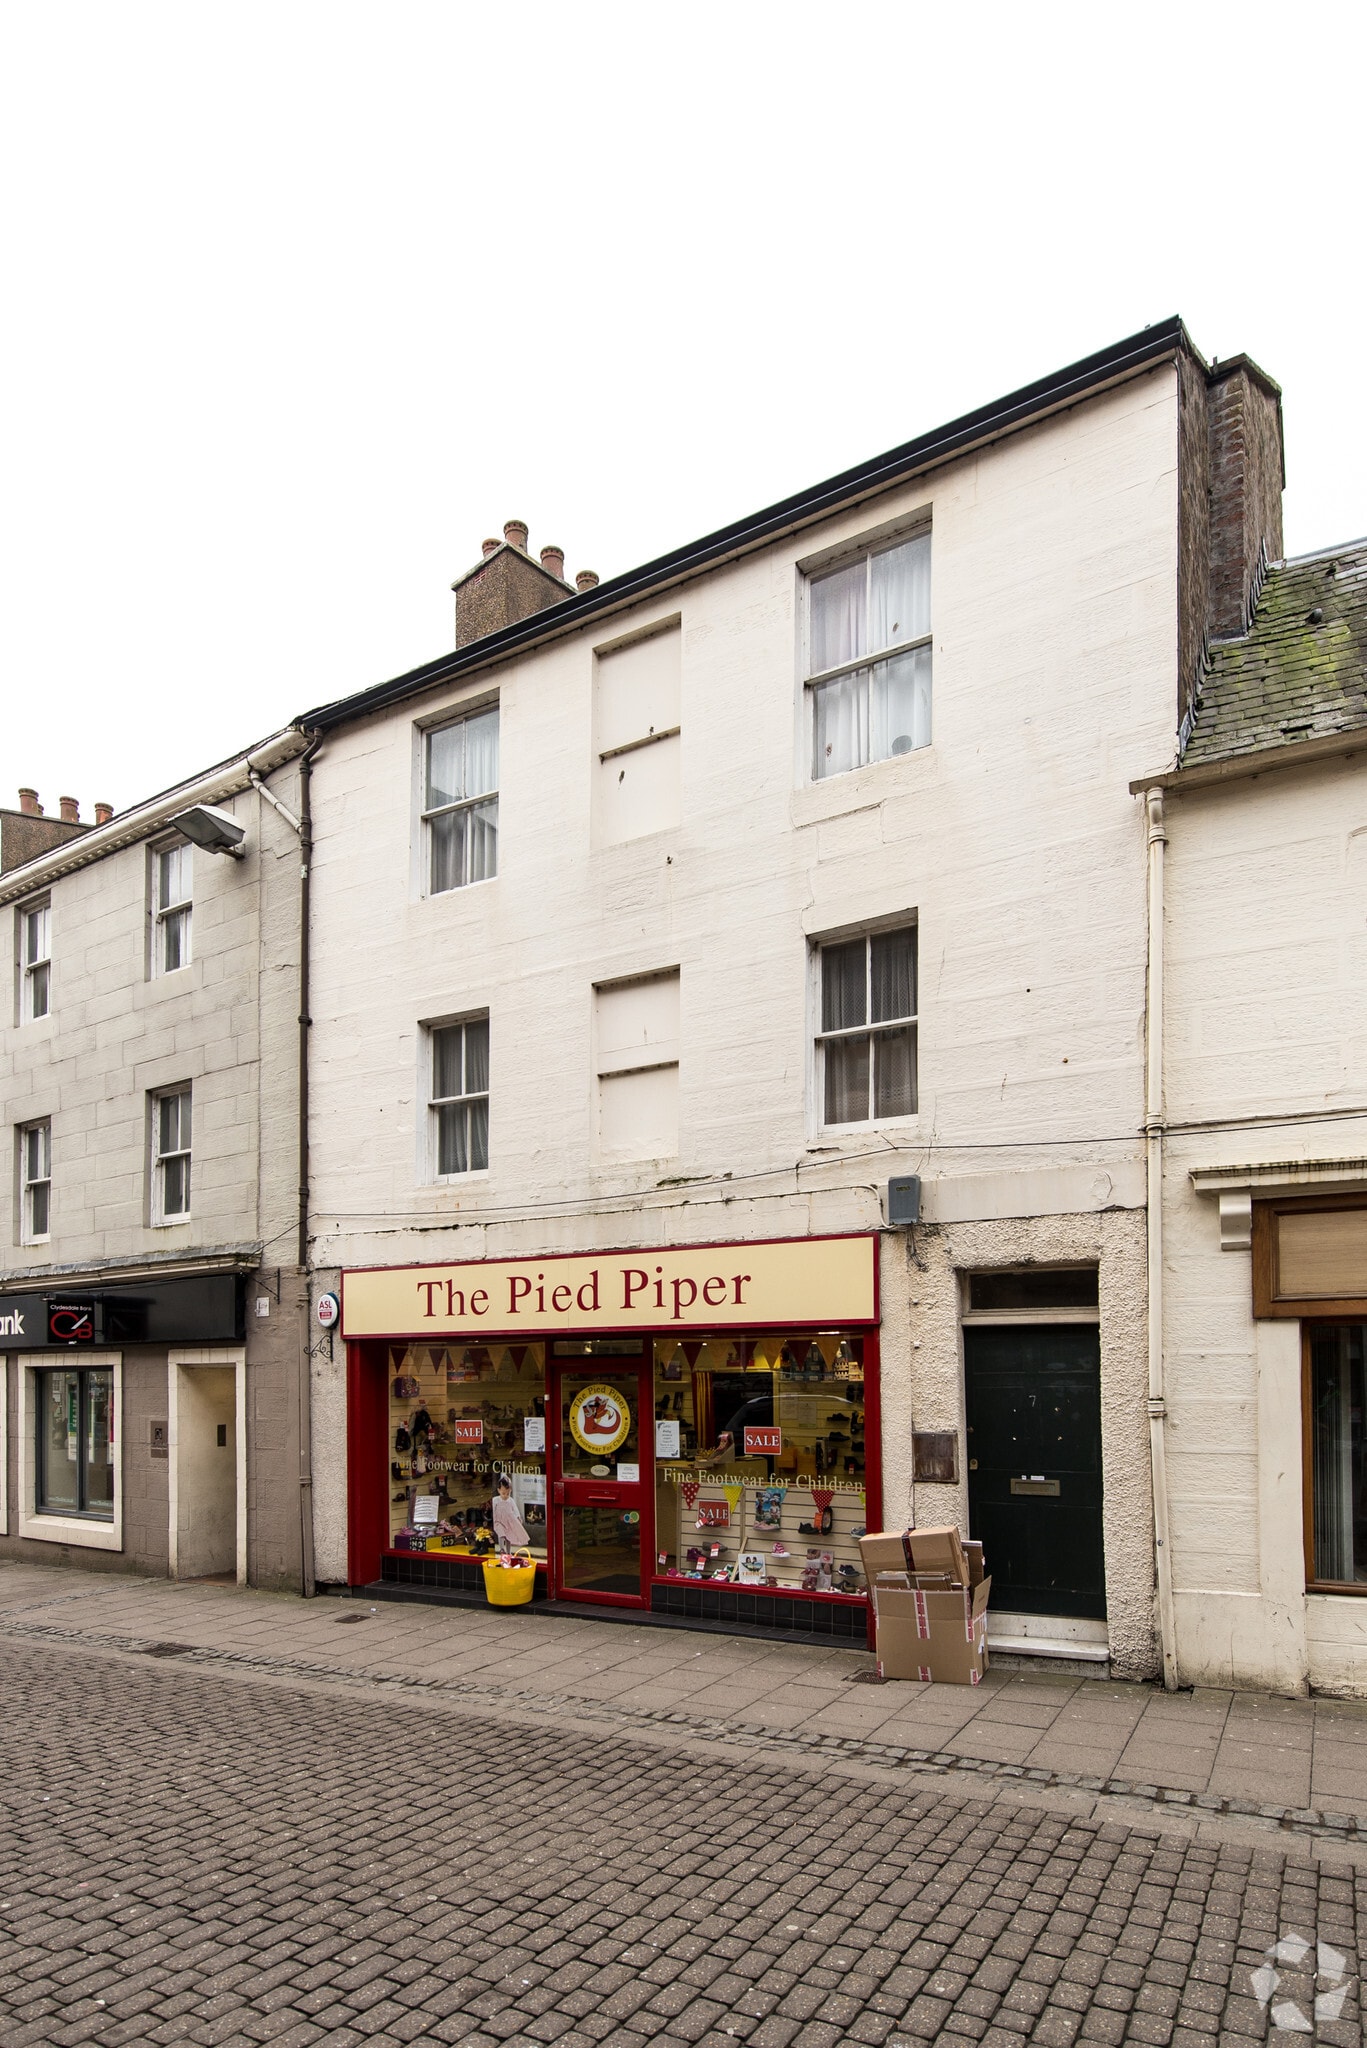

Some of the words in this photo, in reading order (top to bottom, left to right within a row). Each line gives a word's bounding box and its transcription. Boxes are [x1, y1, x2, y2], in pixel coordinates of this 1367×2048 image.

[416, 1279, 490, 1317] The
[506, 1269, 602, 1314] Pied
[619, 1265, 752, 1320] Piper
[318, 1300, 332, 1309] ASL
[573, 1392, 586, 1409] The
[587, 1385, 607, 1395] Pied
[608, 1388, 627, 1410] Piper
[1028, 1395, 1036, 1407] 7
[456, 1427, 482, 1437] SALE
[577, 1434, 601, 1452] Footwear
[745, 1434, 780, 1446] SALE
[423, 1458, 470, 1472] Footwear
[473, 1459, 489, 1473] for
[492, 1460, 541, 1475] Children
[663, 1467, 693, 1483] Fine
[699, 1470, 765, 1487] Footwear
[769, 1473, 791, 1489] for
[796, 1474, 864, 1492] Children
[699, 1507, 728, 1519] SALE
